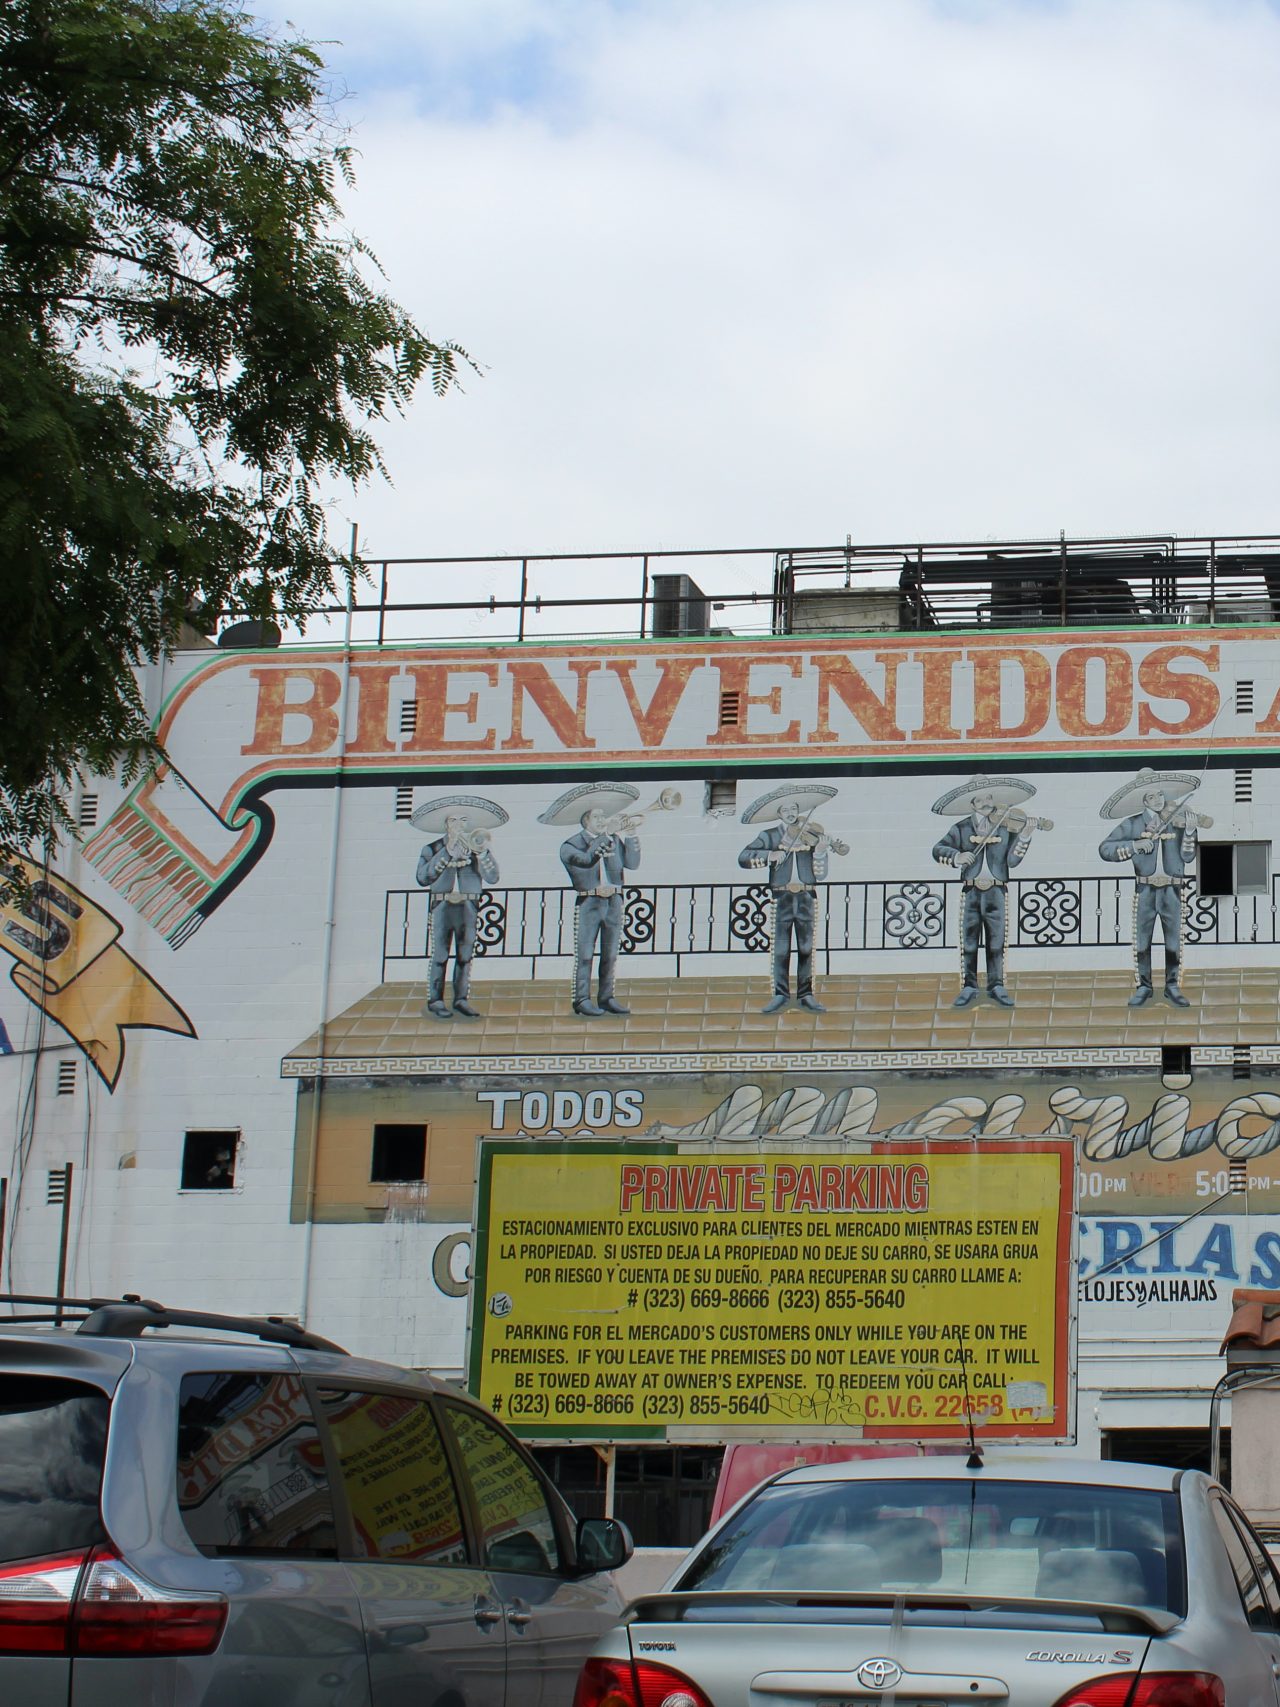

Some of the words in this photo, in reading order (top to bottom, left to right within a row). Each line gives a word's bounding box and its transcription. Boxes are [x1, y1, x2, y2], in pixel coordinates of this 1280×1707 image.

[242, 646, 1219, 755] BIENVENIDOS
[476, 1089, 644, 1130] TODOS
[620, 1164, 766, 1213] PRIVATE
[773, 1164, 929, 1213] PARKING
[503, 1220, 623, 1236] ESTACIONAMIENTO
[628, 1220, 698, 1237] EXCLUSIVO
[703, 1221, 737, 1237] PARA
[742, 1220, 802, 1238] CLIENTES
[807, 1222, 831, 1238] DEL
[836, 1222, 900, 1238] MERCADO
[905, 1220, 972, 1237] MIENTRAS
[977, 1220, 1017, 1236] ESTEN
[1022, 1220, 1038, 1236] EN
[500, 1243, 516, 1260] LA
[521, 1243, 596, 1260] PROPIEDAD.
[604, 1243, 616, 1260] SI
[621, 1244, 662, 1260] USTED
[667, 1244, 700, 1260] DEJA
[705, 1244, 720, 1260] LA
[725, 1245, 798, 1261] PROPIEDAD
[803, 1245, 820, 1261] NO
[825, 1245, 857, 1261] DEJE
[862, 1245, 878, 1261] SU
[883, 1245, 930, 1264] CARRO,
[935, 1243, 950, 1260] SE
[955, 1243, 998, 1260] USARA
[1004, 1243, 1038, 1260] GRUA
[525, 1267, 550, 1284] POR
[555, 1267, 602, 1284] RIESGO
[607, 1267, 614, 1283] Y
[619, 1268, 668, 1284] CUENTA
[674, 1268, 690, 1284] DE
[694, 1268, 711, 1284] SU
[716, 1262, 762, 1284] DUEÑO.
[771, 1268, 804, 1285] PARA
[809, 1268, 886, 1285] RECUPERAR
[891, 1268, 908, 1285] SU
[913, 1267, 956, 1284] CARRO
[961, 1267, 1004, 1284] LLAME
[1009, 1267, 1021, 1283] A:
[644, 1288, 685, 1313] (323)
[691, 1288, 769, 1309] 669-8666
[778, 1289, 819, 1313] (323)
[826, 1289, 905, 1309] 855-5640
[1148, 1280, 1218, 1302] ALHAJAS
[506, 1324, 568, 1341] PARKING
[574, 1324, 601, 1341] FOR
[607, 1325, 623, 1341] EL
[720, 1325, 810, 1341] CUSTOMERS
[815, 1325, 851, 1341] ONLY
[857, 1325, 902, 1341] WHILE
[908, 1324, 936, 1341] YOU
[941, 1324, 970, 1341] ARE
[975, 1324, 994, 1341] ON
[1000, 1324, 1027, 1340] THE
[491, 1348, 568, 1365] PREMISES.
[578, 1348, 590, 1365] IF
[596, 1348, 624, 1365] YOU
[629, 1348, 674, 1365] LEAVE
[679, 1349, 706, 1365] THE
[712, 1348, 785, 1366] PREMISES
[791, 1349, 811, 1366] DO
[816, 1349, 845, 1366] NOT
[850, 1348, 895, 1366] LEAVE
[901, 1348, 938, 1364] YOUR
[944, 1348, 977, 1364] CAR.
[987, 1348, 1000, 1364] IT
[1005, 1348, 1039, 1364] WILL
[515, 1372, 533, 1389] BE
[538, 1372, 590, 1389] TOWED
[595, 1373, 636, 1389] AWAY
[642, 1373, 659, 1389] AT
[737, 1373, 806, 1390] EXPENSE.
[816, 1373, 834, 1389] TO
[840, 1373, 899, 1390] REDEEM
[905, 1373, 933, 1390] YOU
[939, 1373, 967, 1390] CAR
[508, 1393, 549, 1418] (323)
[555, 1393, 633, 1414] 669-8666
[643, 1394, 684, 1419] (323)
[690, 1394, 769, 1415] 855-5640
[865, 1394, 928, 1419] C.V.C.
[935, 1393, 1003, 1418] 22658
[638, 1640, 677, 1652] TOYOTA
[1025, 1649, 1106, 1665] COROLLA
[1108, 1649, 1135, 1665] S
